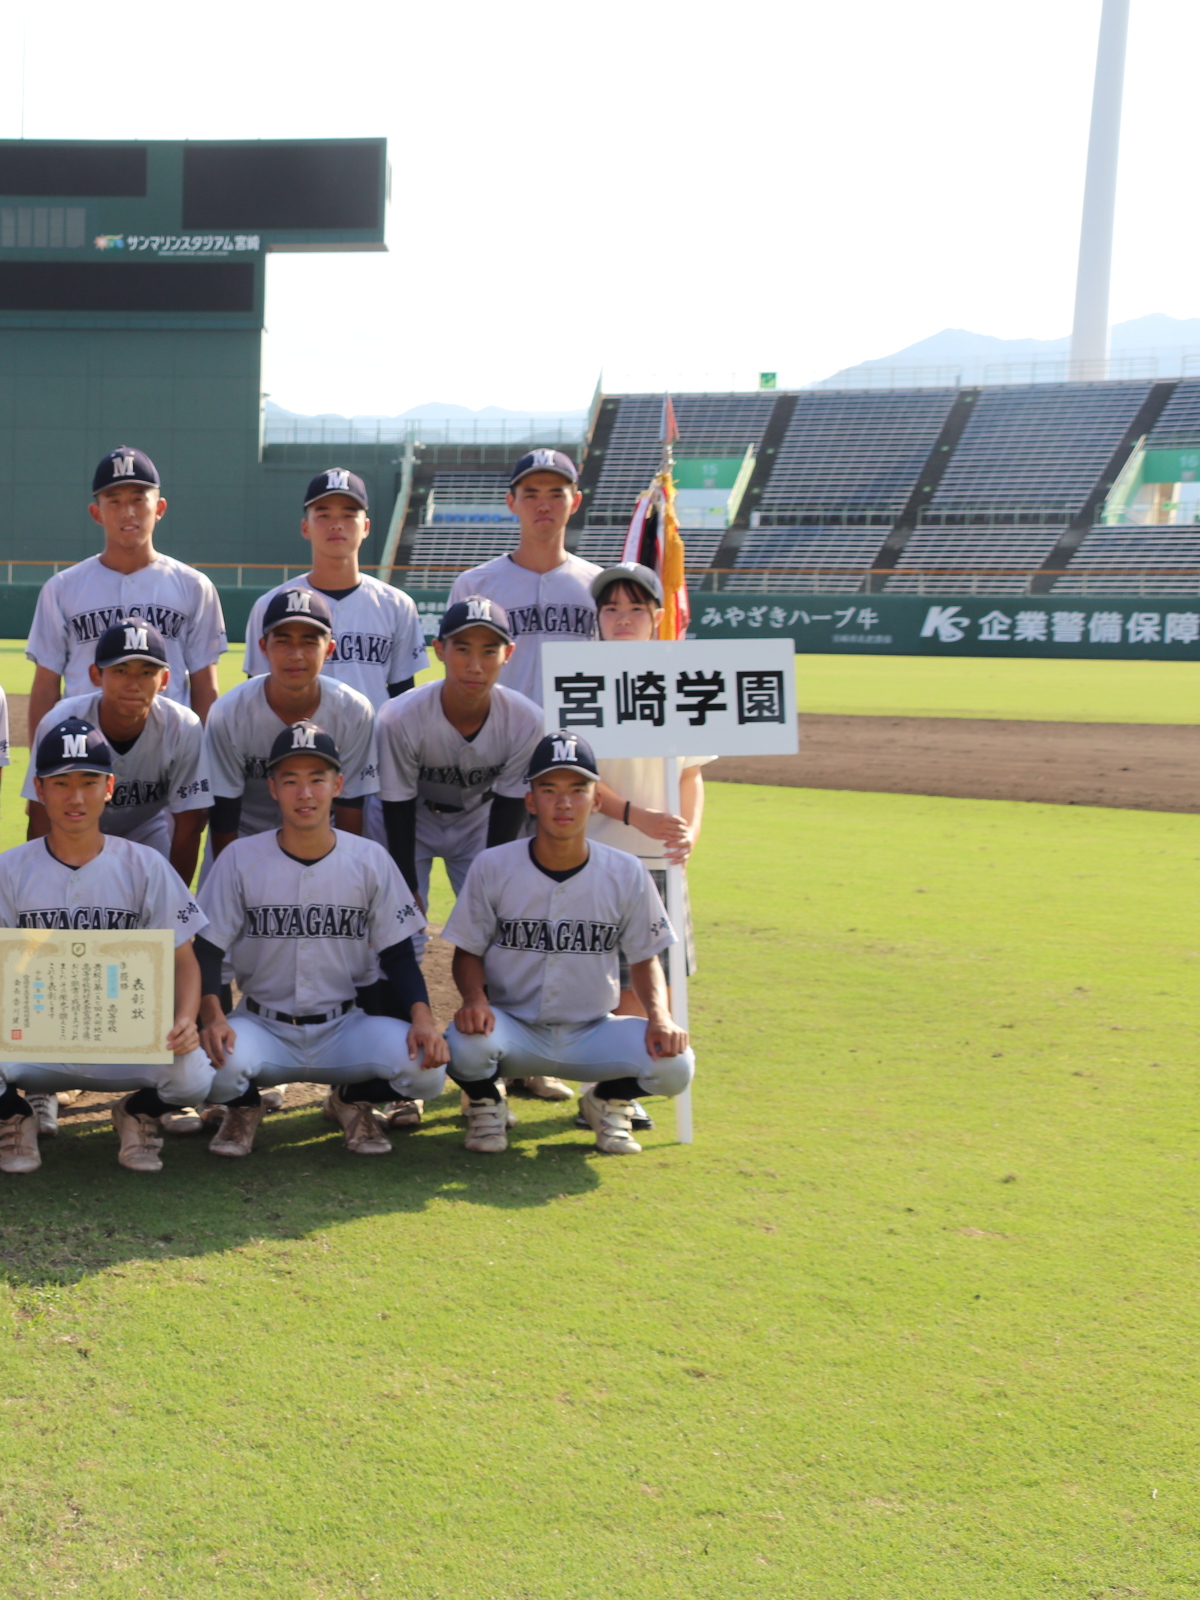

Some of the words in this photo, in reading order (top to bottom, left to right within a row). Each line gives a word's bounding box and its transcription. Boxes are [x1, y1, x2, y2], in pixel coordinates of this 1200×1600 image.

[127, 234, 260, 251] サンマリンスタジアム宮崎
[112, 456, 136, 478] M
[532, 451, 555, 467] M
[326, 472, 350, 490] M
[286, 592, 312, 613] M
[466, 600, 492, 621] M
[701, 605, 880, 630] みやざきハーブ牛
[977, 610, 1200, 644] 企業警備保障
[124, 627, 149, 651] M
[554, 670, 786, 728] 宮崎学園
[62, 734, 89, 758] M
[291, 728, 317, 750] M
[551, 740, 578, 763] M
[131, 977, 146, 1020] 表彰状
[107, 1003, 118, 1033] 高等学校
